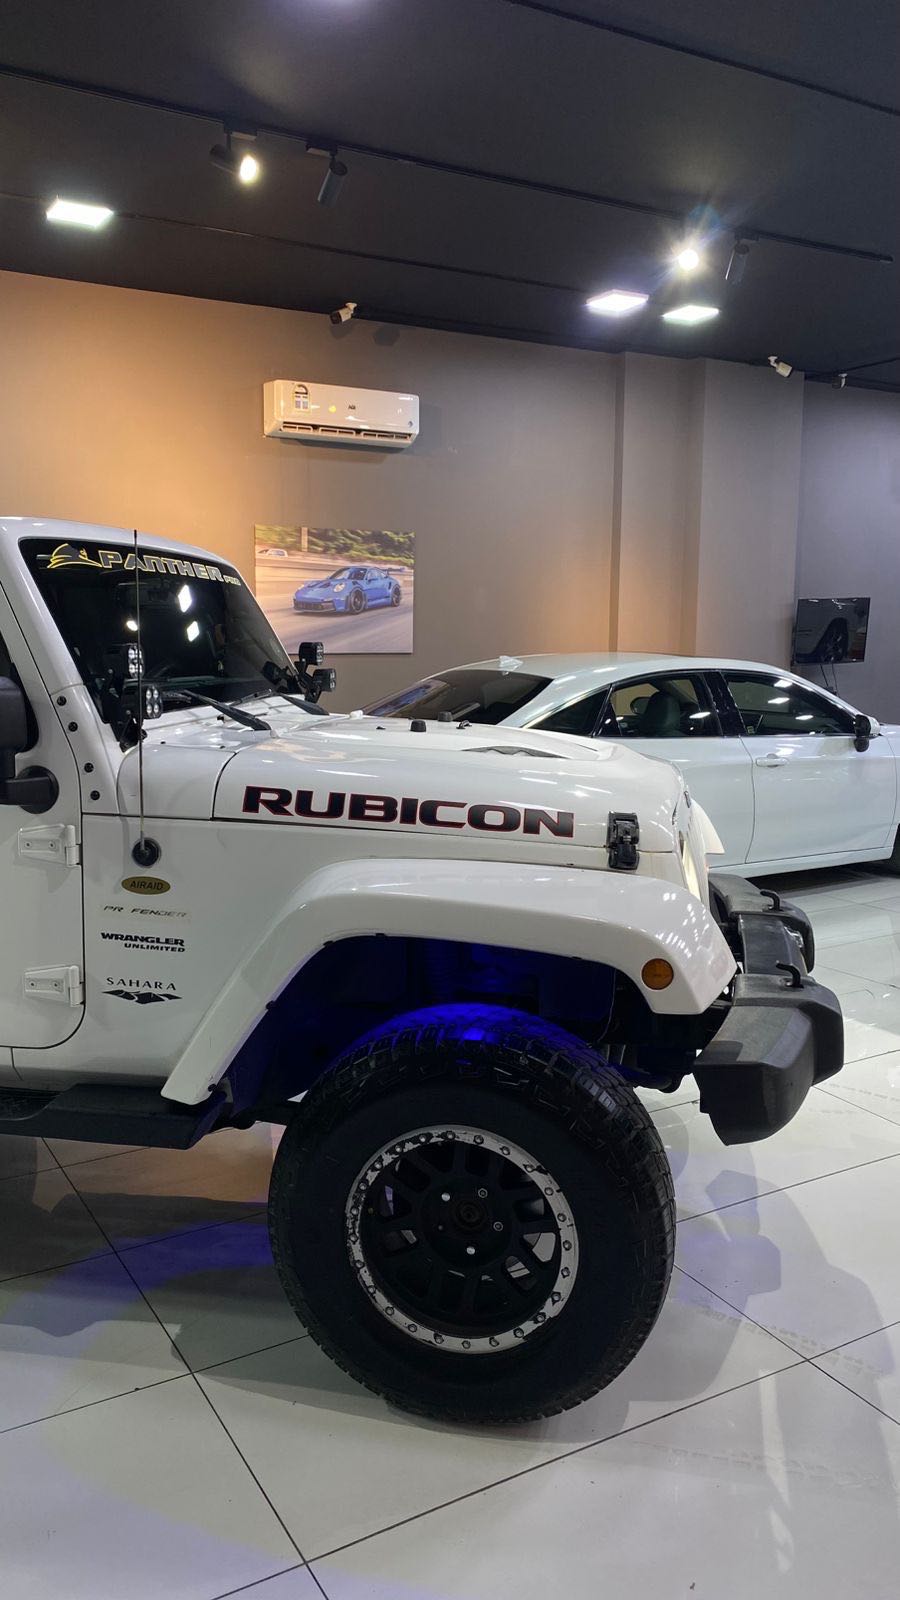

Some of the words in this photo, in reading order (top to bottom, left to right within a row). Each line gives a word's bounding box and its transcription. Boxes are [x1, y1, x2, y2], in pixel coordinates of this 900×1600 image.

[98, 550, 224, 582] PANTHER
[242, 785, 575, 838] RUBICON
[129, 881, 164, 891] AIRAID
[130, 908, 187, 917] FENDER
[100, 932, 185, 947] WRANGLER
[124, 943, 185, 953] UNLIMITED
[106, 977, 176, 990] SAHARA
